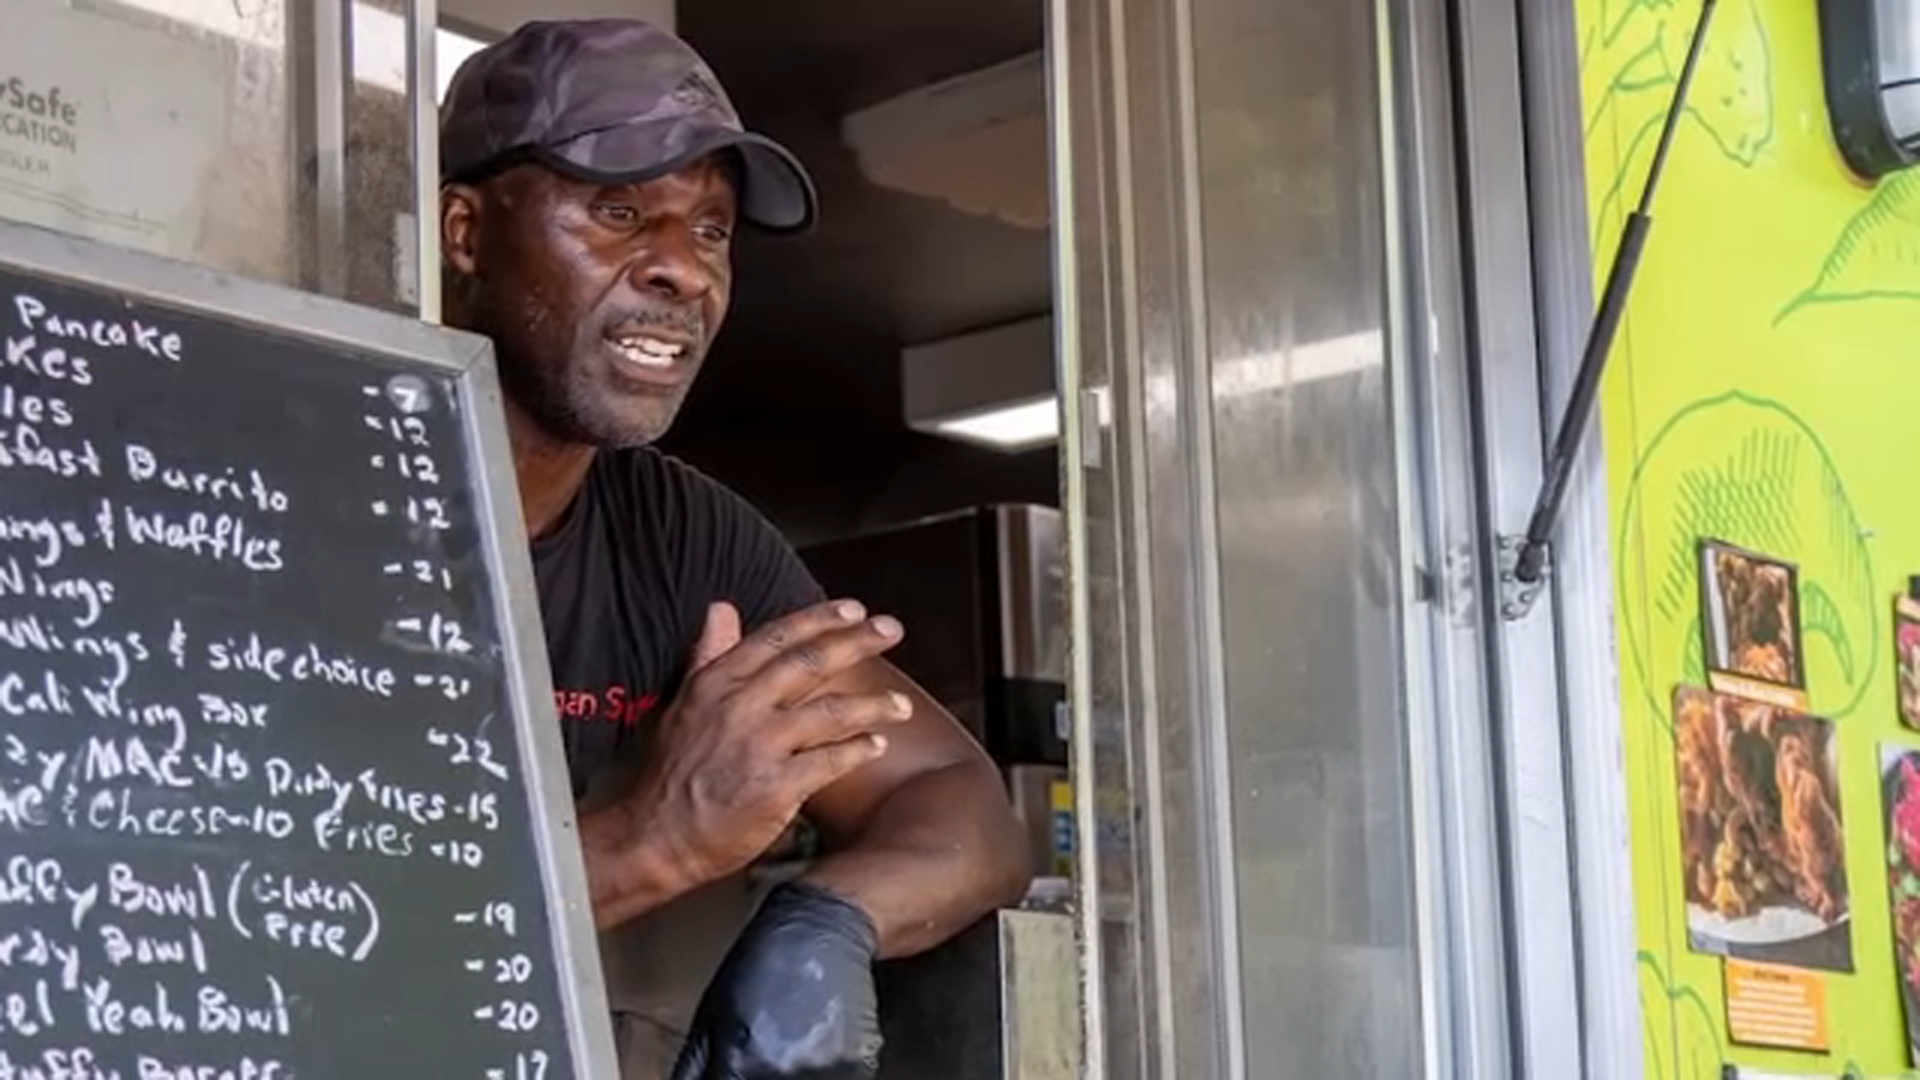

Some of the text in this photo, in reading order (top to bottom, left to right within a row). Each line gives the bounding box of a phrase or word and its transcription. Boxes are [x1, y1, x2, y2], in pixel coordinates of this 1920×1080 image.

[0, 112, 77, 155] CATION
[14, 294, 182, 361] Pancake
[0, 335, 92, 385] kes
[126, 444, 289, 512] Burrito
[125, 505, 284, 570] Waffles
[108, 862, 217, 918] Bowl
[100, 924, 207, 973] Bowl
[83, 974, 186, 1035] Yeah
[198, 974, 289, 1036] Bowl
